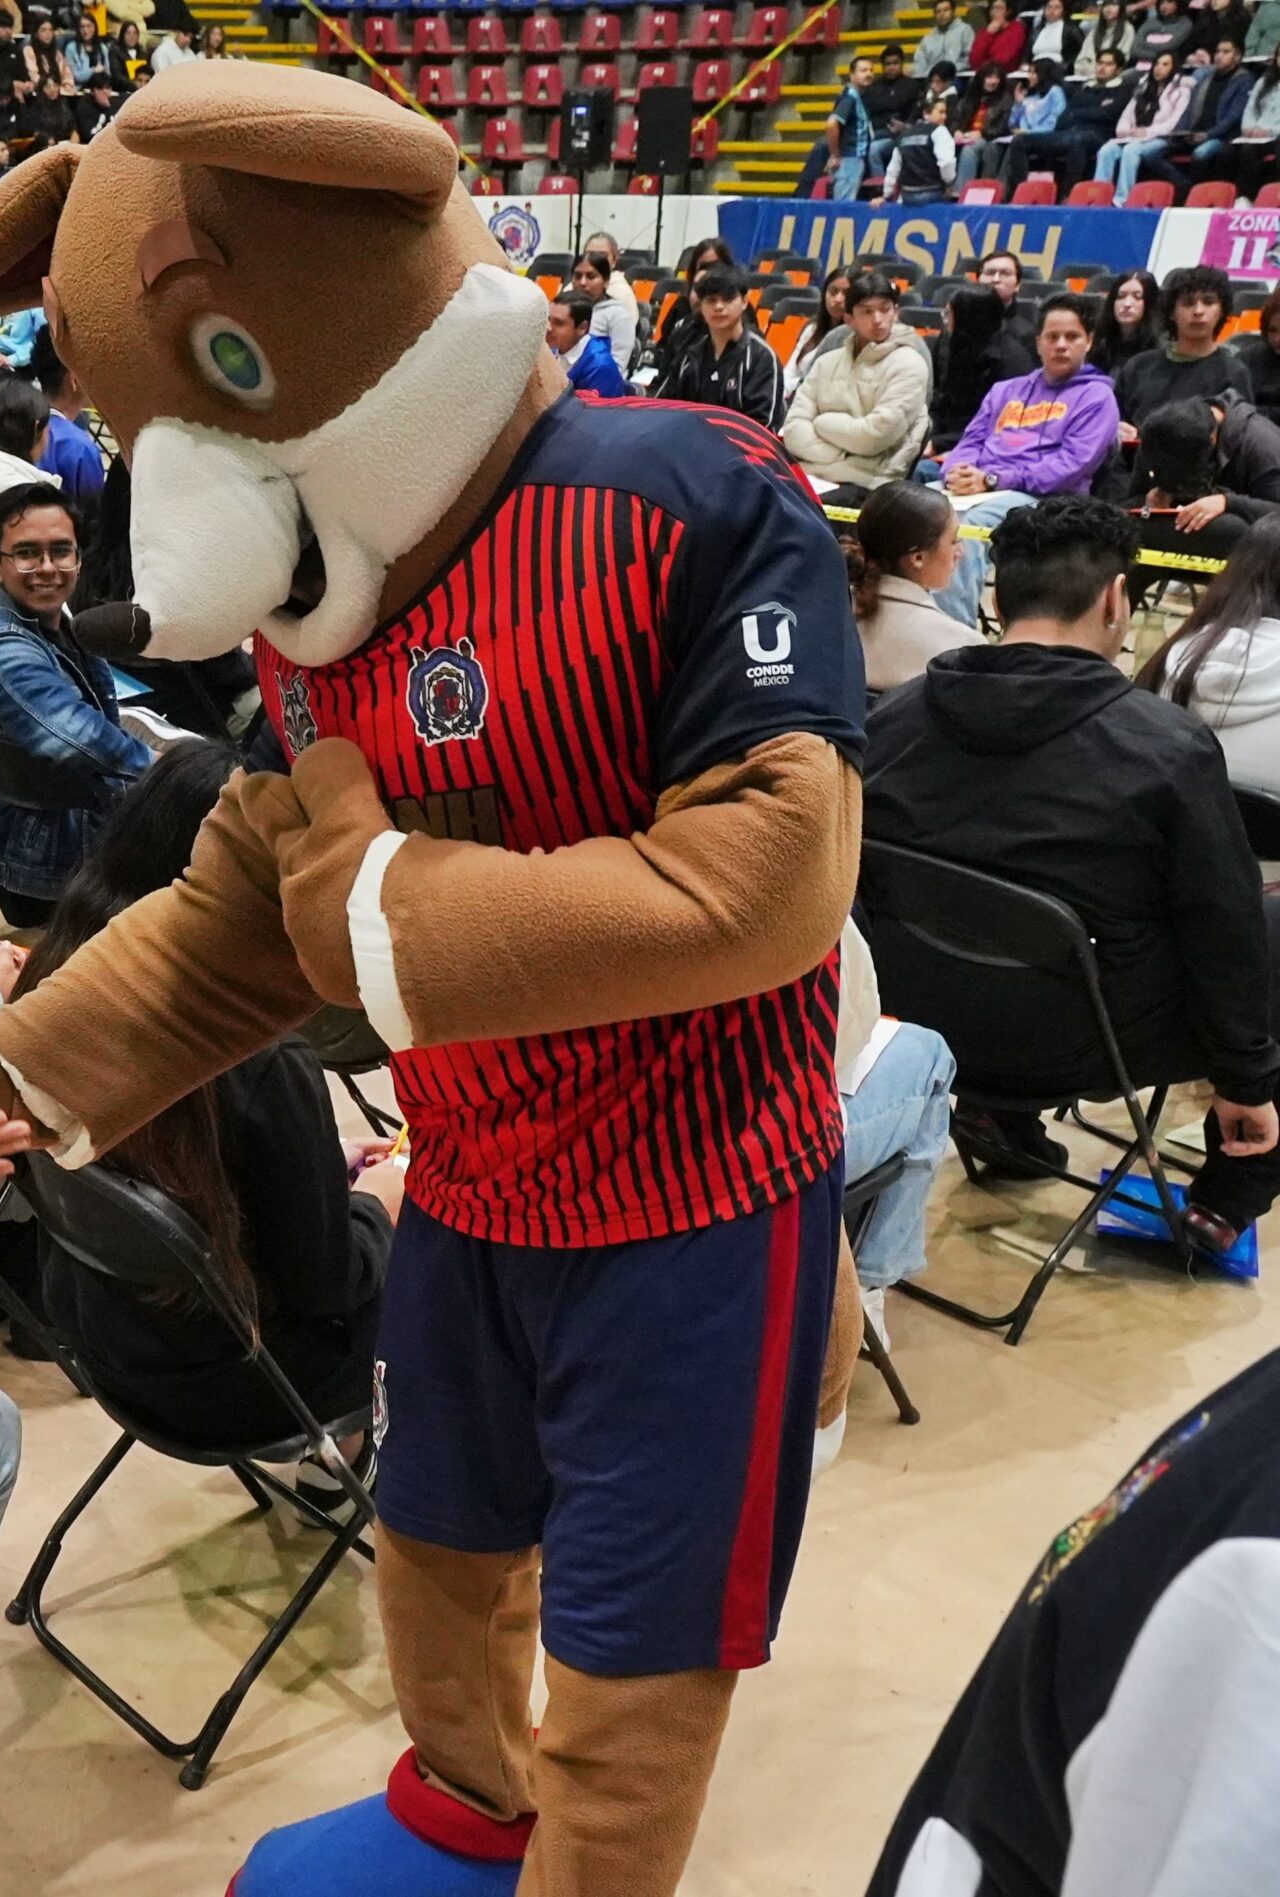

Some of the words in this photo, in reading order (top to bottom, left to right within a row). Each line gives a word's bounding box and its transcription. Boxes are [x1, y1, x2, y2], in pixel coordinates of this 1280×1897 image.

[1227, 213, 1280, 232] ZONA
[1226, 235, 1269, 270] 11
[746, 664, 795, 678] CONDDE
